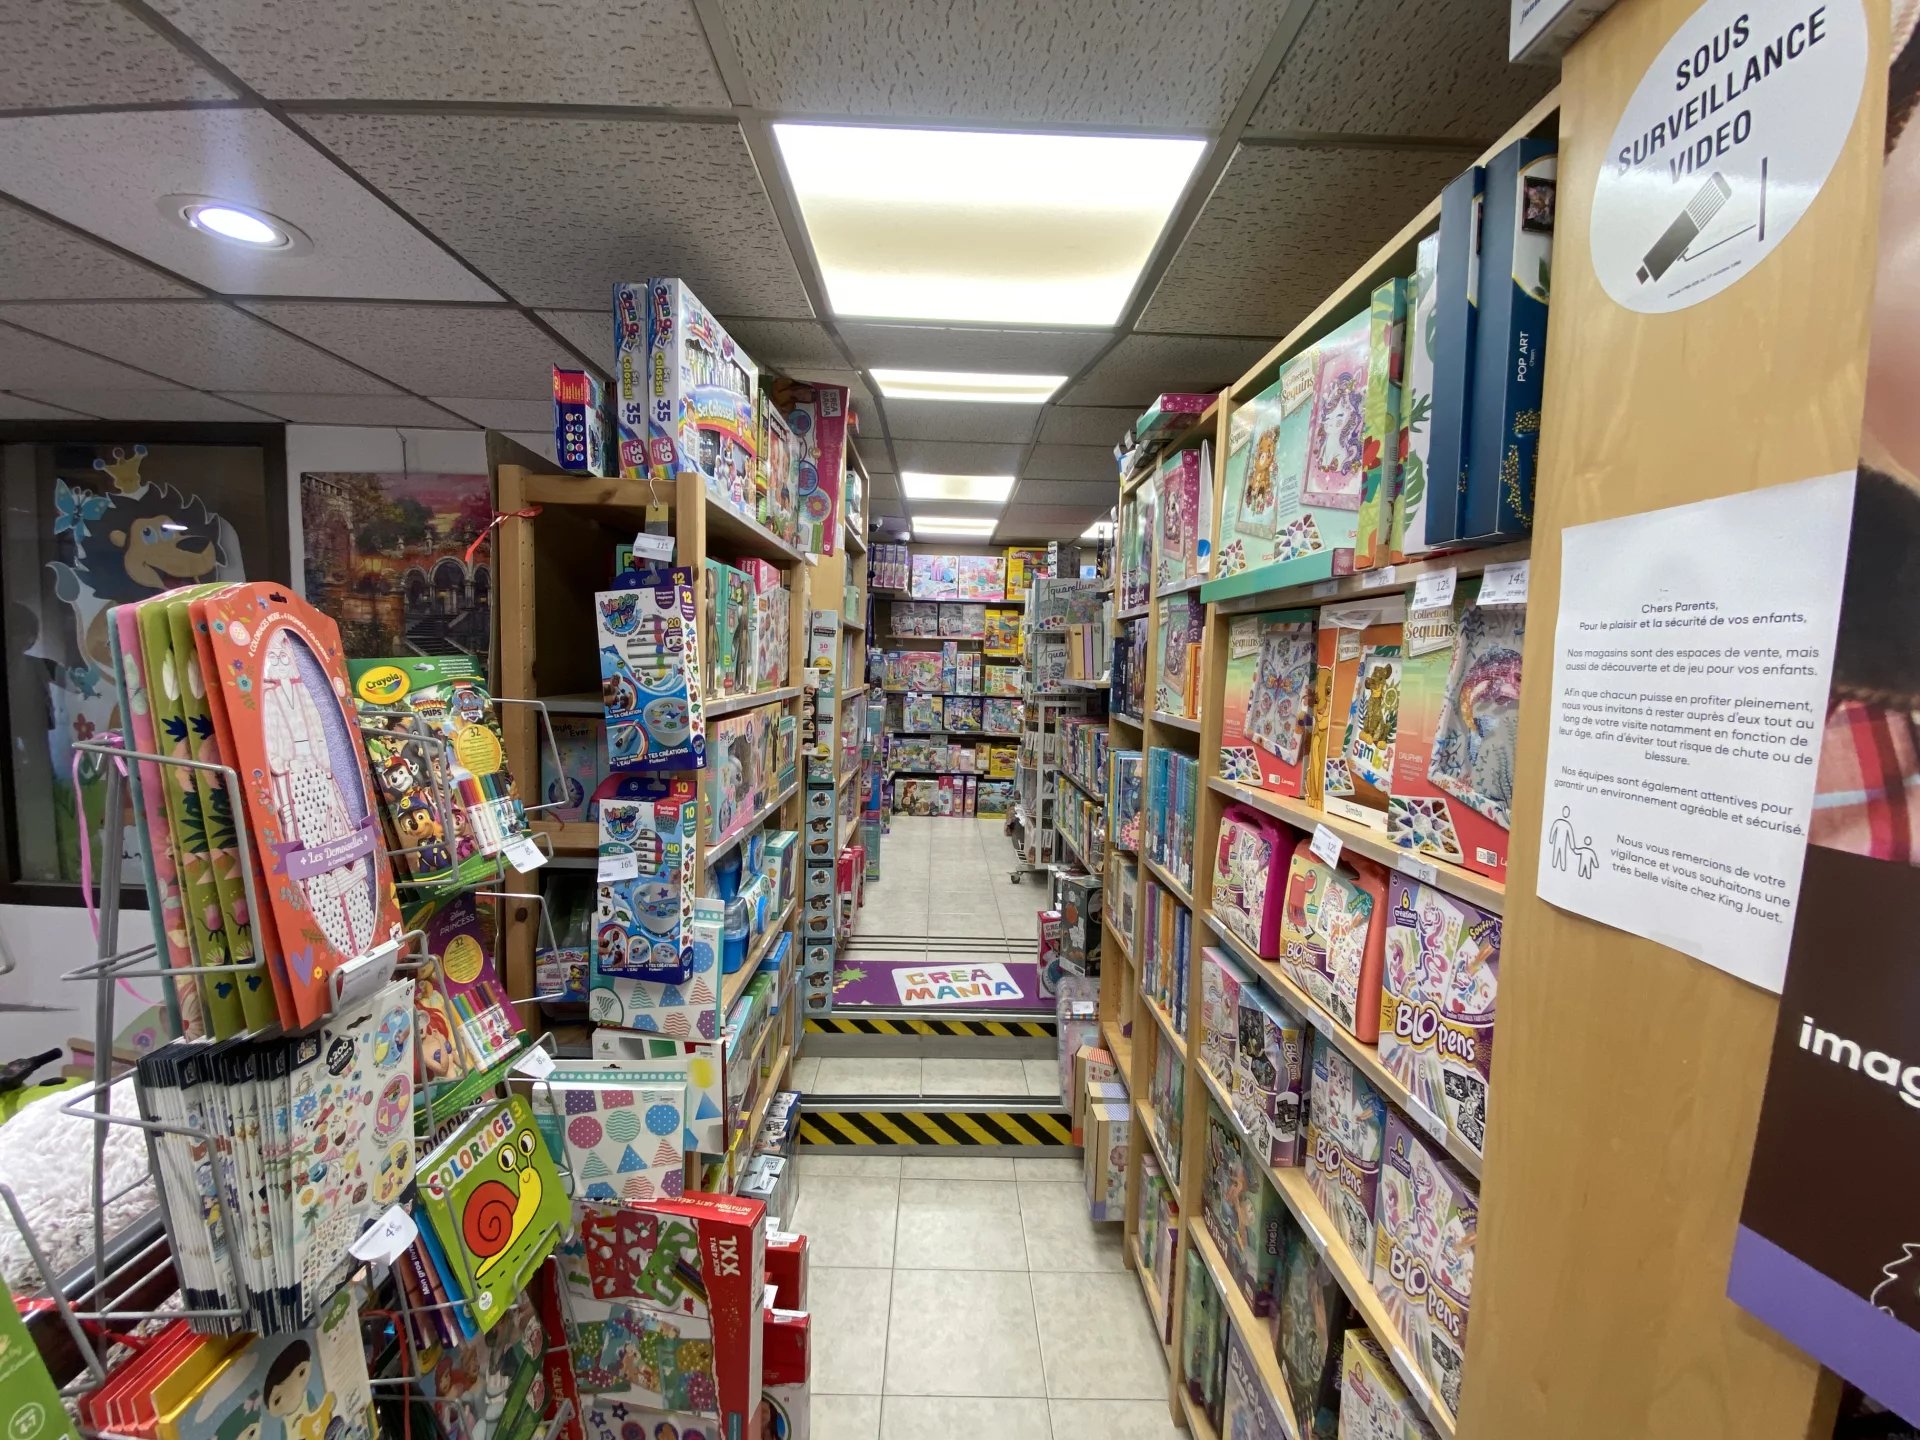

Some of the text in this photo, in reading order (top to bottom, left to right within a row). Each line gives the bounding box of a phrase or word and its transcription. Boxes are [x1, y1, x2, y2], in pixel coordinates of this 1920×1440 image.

[1676, 14, 1749, 92] SOUS
[1617, 6, 1826, 176] SURVEILLANCE
[1670, 109, 1752, 184] VIDEO
[1517, 331, 1529, 381] POP ART
[623, 356, 633, 400] Colossal
[655, 352, 665, 396] Colossal
[1281, 377, 1314, 404] Sequins
[626, 402, 641, 424] 35
[657, 400, 671, 422] 35
[672, 573, 686, 585] 12
[682, 591, 692, 604] 12
[1641, 601, 1719, 614] Chers Parents,
[667, 617, 681, 628] 20
[1414, 608, 1449, 620] Collection
[1579, 612, 1807, 631] Pour le plaisir et la sécurité de vos enfants,
[1405, 621, 1457, 643] Sequins
[1567, 646, 1820, 660] Nos magasins sont des espaces de vente, mais
[365, 671, 400, 690] Crayola
[1565, 662, 1818, 676] aussi de découverte et de jeu pour vos enfants.
[1564, 688, 1813, 713] Afin que chacun puisse en profiter pleinement,
[422, 709, 442, 717] PUPS
[1562, 702, 1814, 729] nous vous invitons à rester auprès d'eux tout au
[469, 727, 481, 738] 32
[1563, 713, 1808, 747] long de votre visite notamment en fonction de
[1353, 740, 1394, 771] Simba
[1559, 726, 1813, 765] leur âge, afin d'éviter tout risque de chute ou de
[1644, 750, 1690, 765] blessure.
[676, 782, 688, 793] 10
[1562, 765, 1794, 816] Nos équipes sont également attentives pour
[685, 806, 695, 819] 10
[1345, 804, 1363, 818] Simba
[1554, 779, 1805, 836] garantir un environnement agréable et sécurisé.
[307, 850, 324, 864] Les
[324, 836, 364, 859] Demoiselles
[667, 843, 680, 853] 40
[1616, 834, 1786, 888] Nous vous remercions de votre
[1610, 848, 1791, 908] vigilance et vous souhaitons une
[1402, 889, 1410, 908] 6
[1612, 862, 1783, 924] très belle visite chez King Jouet.
[440, 914, 475, 936] PRINCESS
[905, 968, 993, 985] CREA
[905, 981, 1018, 1001] MANIA
[328, 1041, 348, 1063] +200
[1437, 1022, 1475, 1061] pens
[1340, 1165, 1362, 1196] pens
[1267, 1221, 1278, 1256] pixelo
[718, 1235, 741, 1277] XXL
[413, 1257, 430, 1297] Mon gros
[1427, 1286, 1460, 1337] pens
